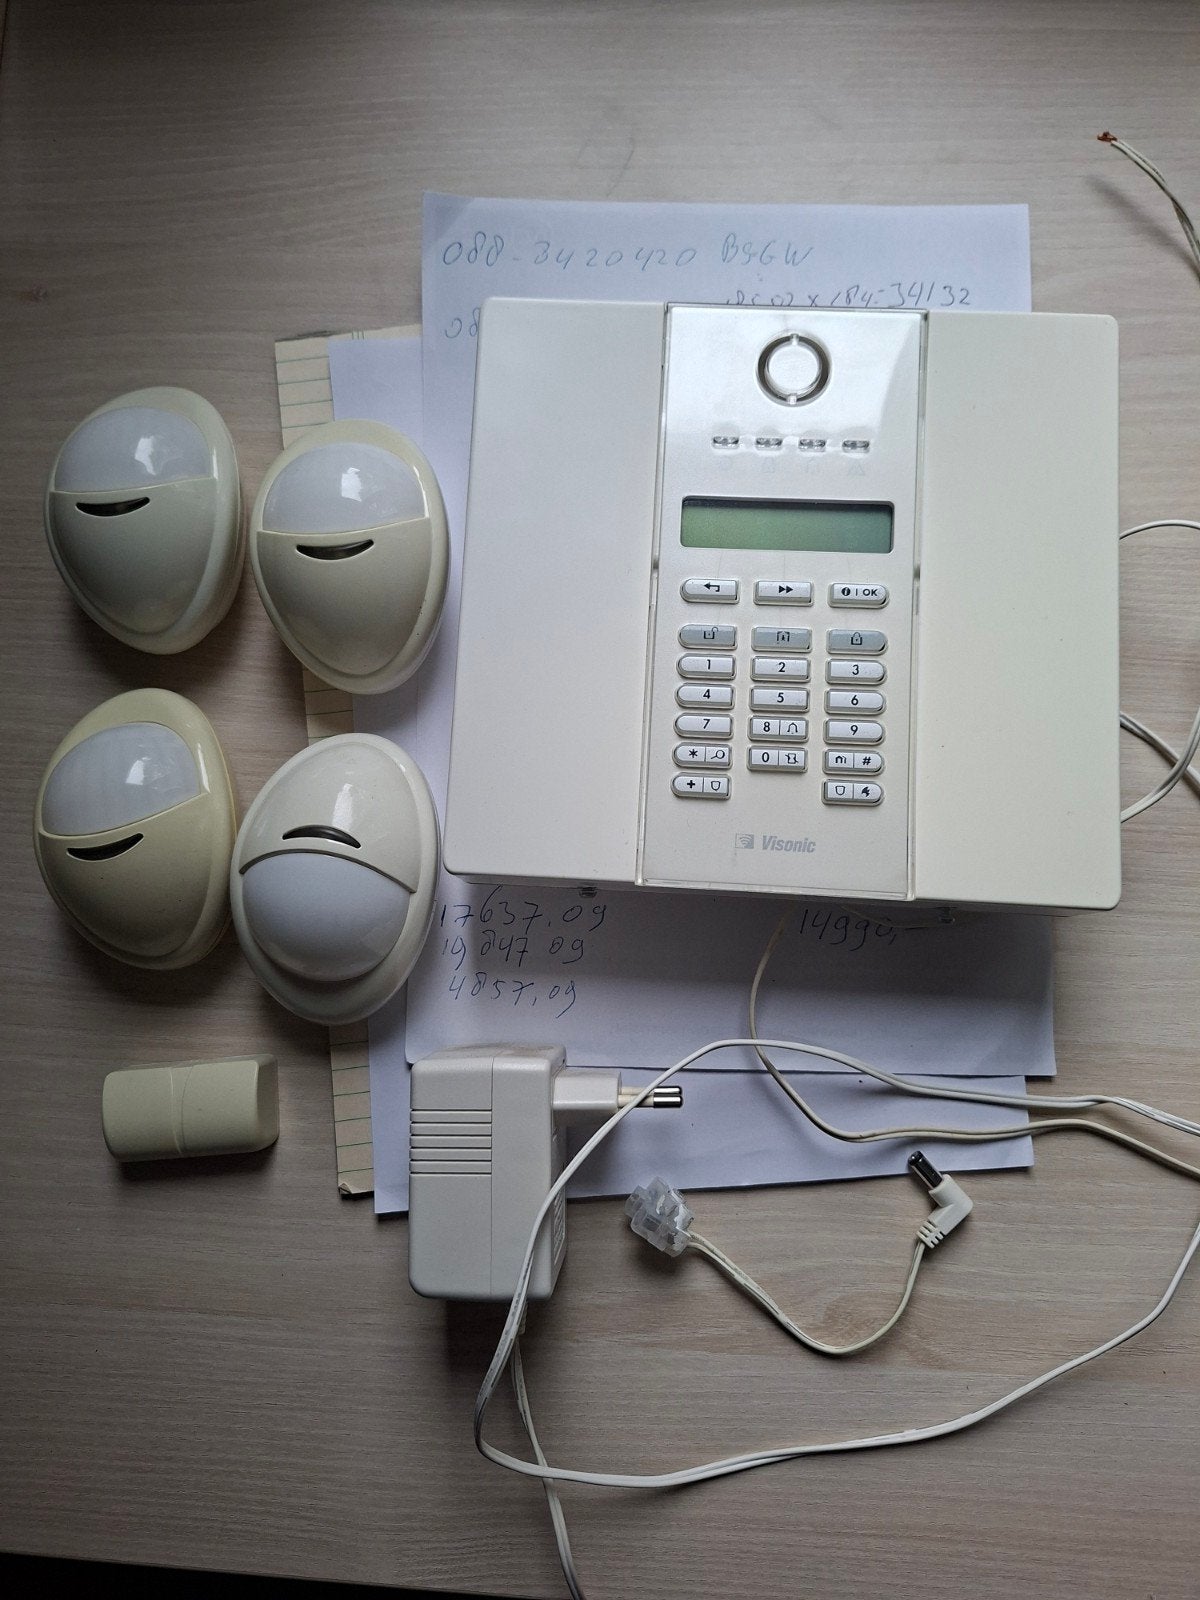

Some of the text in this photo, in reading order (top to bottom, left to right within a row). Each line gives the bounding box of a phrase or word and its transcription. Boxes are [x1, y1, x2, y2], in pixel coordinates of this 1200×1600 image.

[862, 588, 878, 597] OK
[706, 659, 711, 670] 1
[778, 662, 786, 673] 2
[852, 665, 859, 675] 3
[702, 689, 711, 700] 4
[777, 692, 784, 703] 5
[851, 694, 859, 706] 6
[702, 719, 710, 729] 7
[763, 721, 771, 733] 8
[850, 725, 858, 736] 9
[761, 752, 770, 763] 0
[761, 834, 817, 854] Visonic
